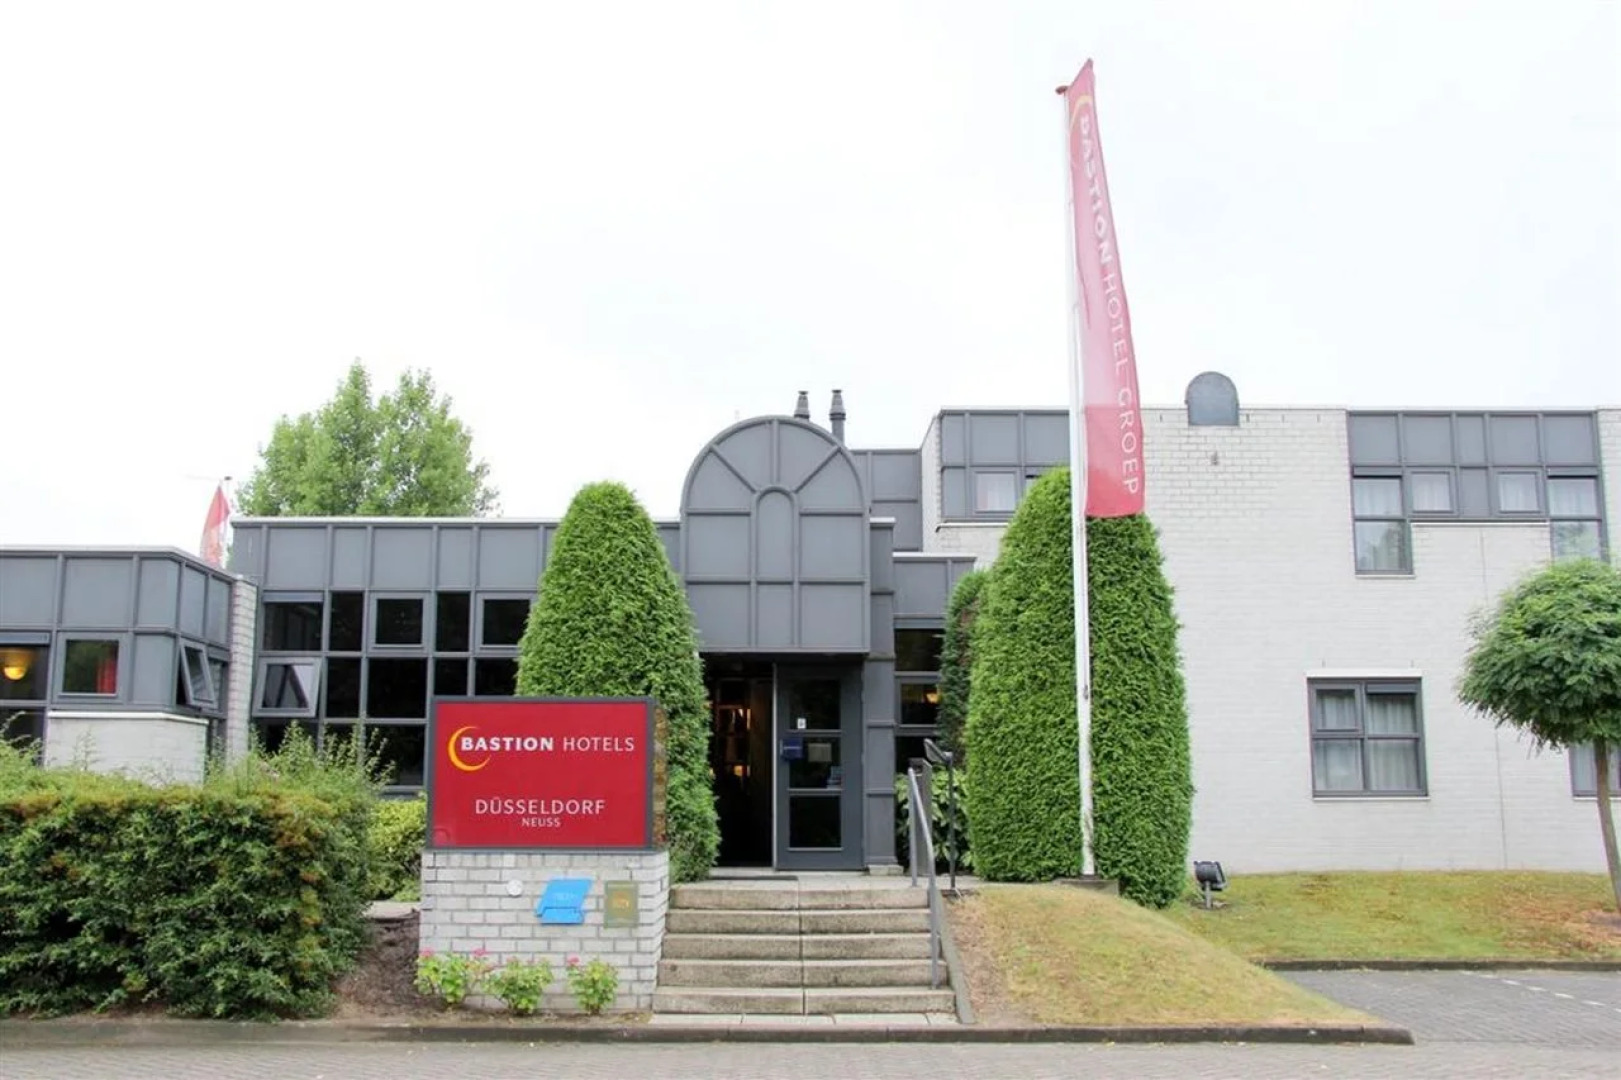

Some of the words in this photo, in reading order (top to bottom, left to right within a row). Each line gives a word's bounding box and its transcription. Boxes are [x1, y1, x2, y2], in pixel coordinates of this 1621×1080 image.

[1103, 273, 1128, 374] HOTEL
[1118, 389, 1140, 495] GROEP
[460, 736, 554, 752] BASTION
[563, 736, 635, 752] HOTELS
[475, 797, 606, 815] DÜSSELDORF
[521, 817, 561, 828] NEUSS
